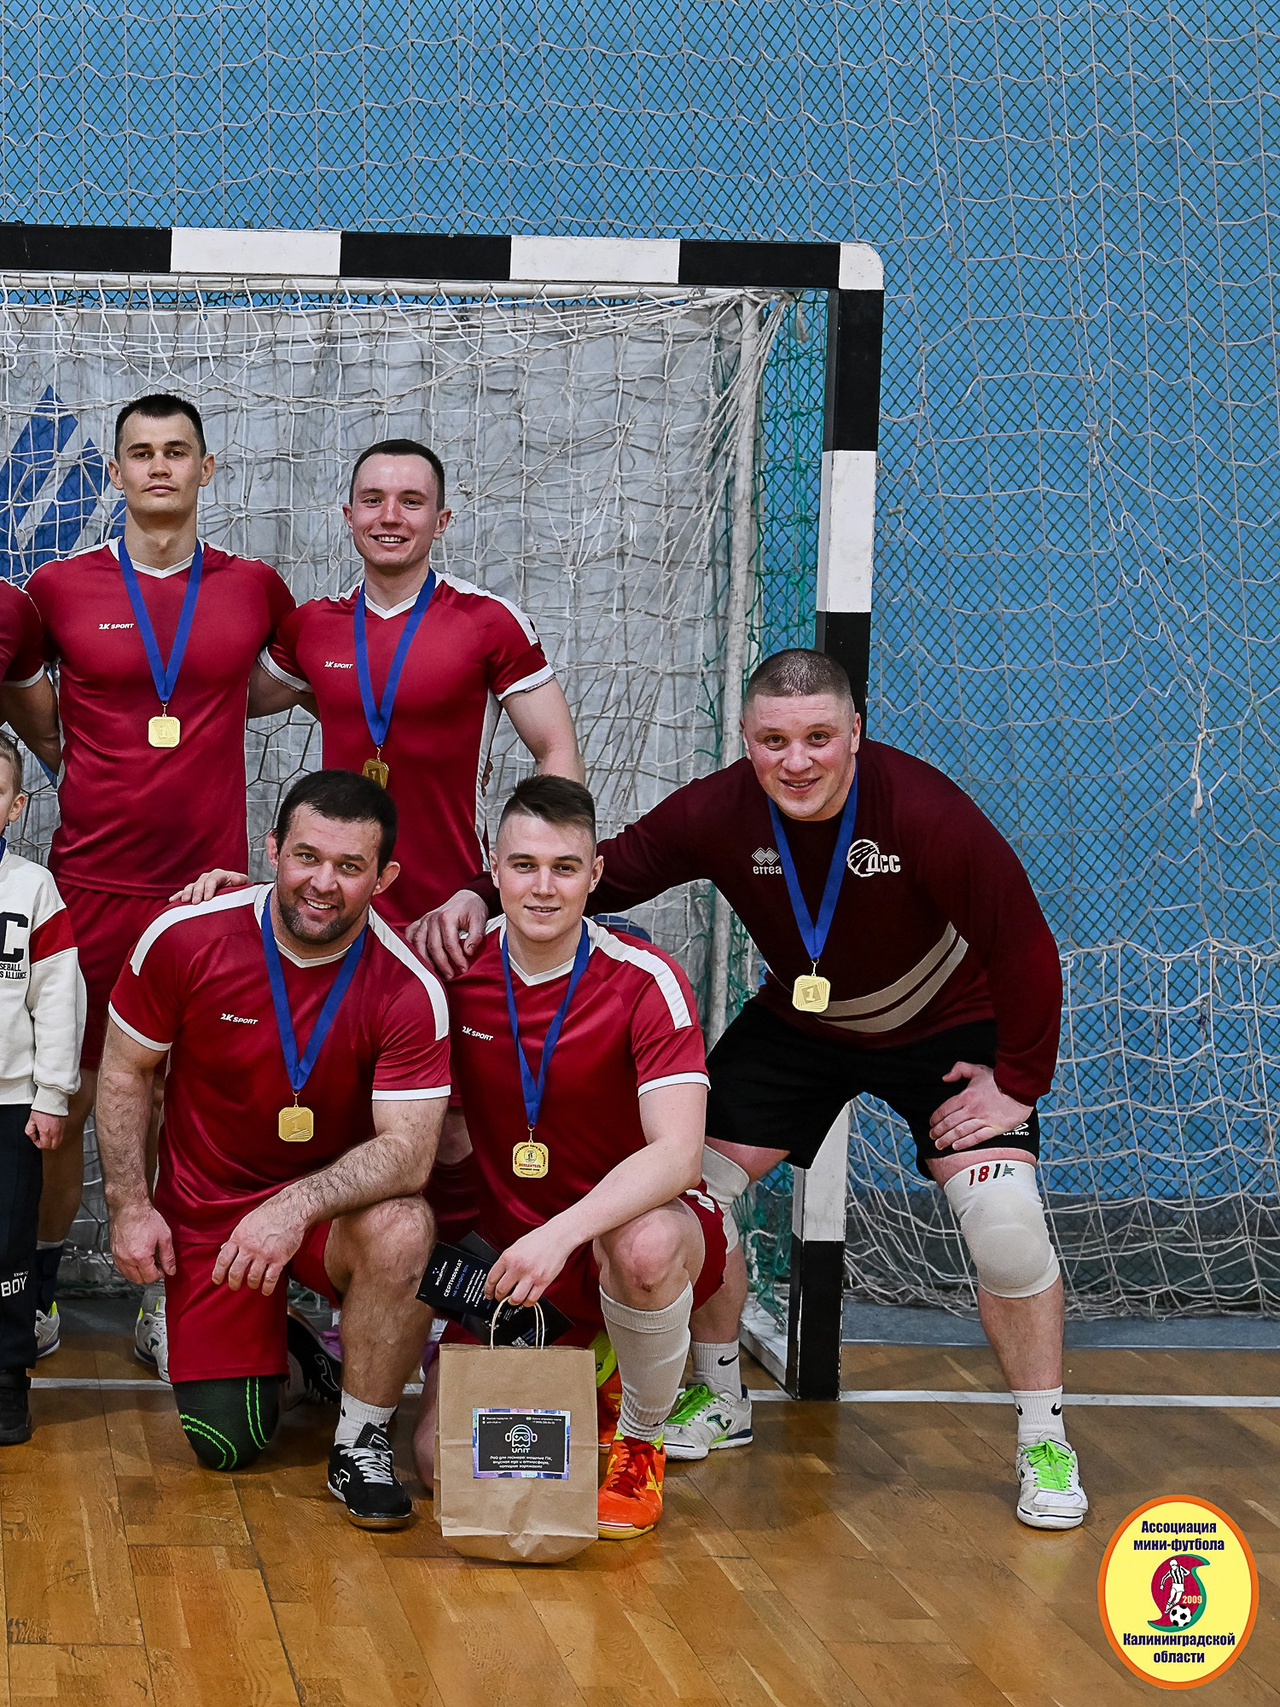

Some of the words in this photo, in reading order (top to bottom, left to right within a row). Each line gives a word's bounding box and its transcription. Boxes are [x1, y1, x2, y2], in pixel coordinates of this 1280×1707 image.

[865, 853, 901, 873] ДСС
[5, 971, 27, 980] ALLIANCE
[220, 1012, 235, 1021] 2K
[233, 1016, 258, 1025] SPORT
[462, 1025, 473, 1035] 2K
[471, 1030, 494, 1041] SPORT
[968, 1163, 1001, 1187] 181
[0, 1276, 28, 1297] BOY
[443, 1259, 463, 1297] СЕРТИФИКАТ
